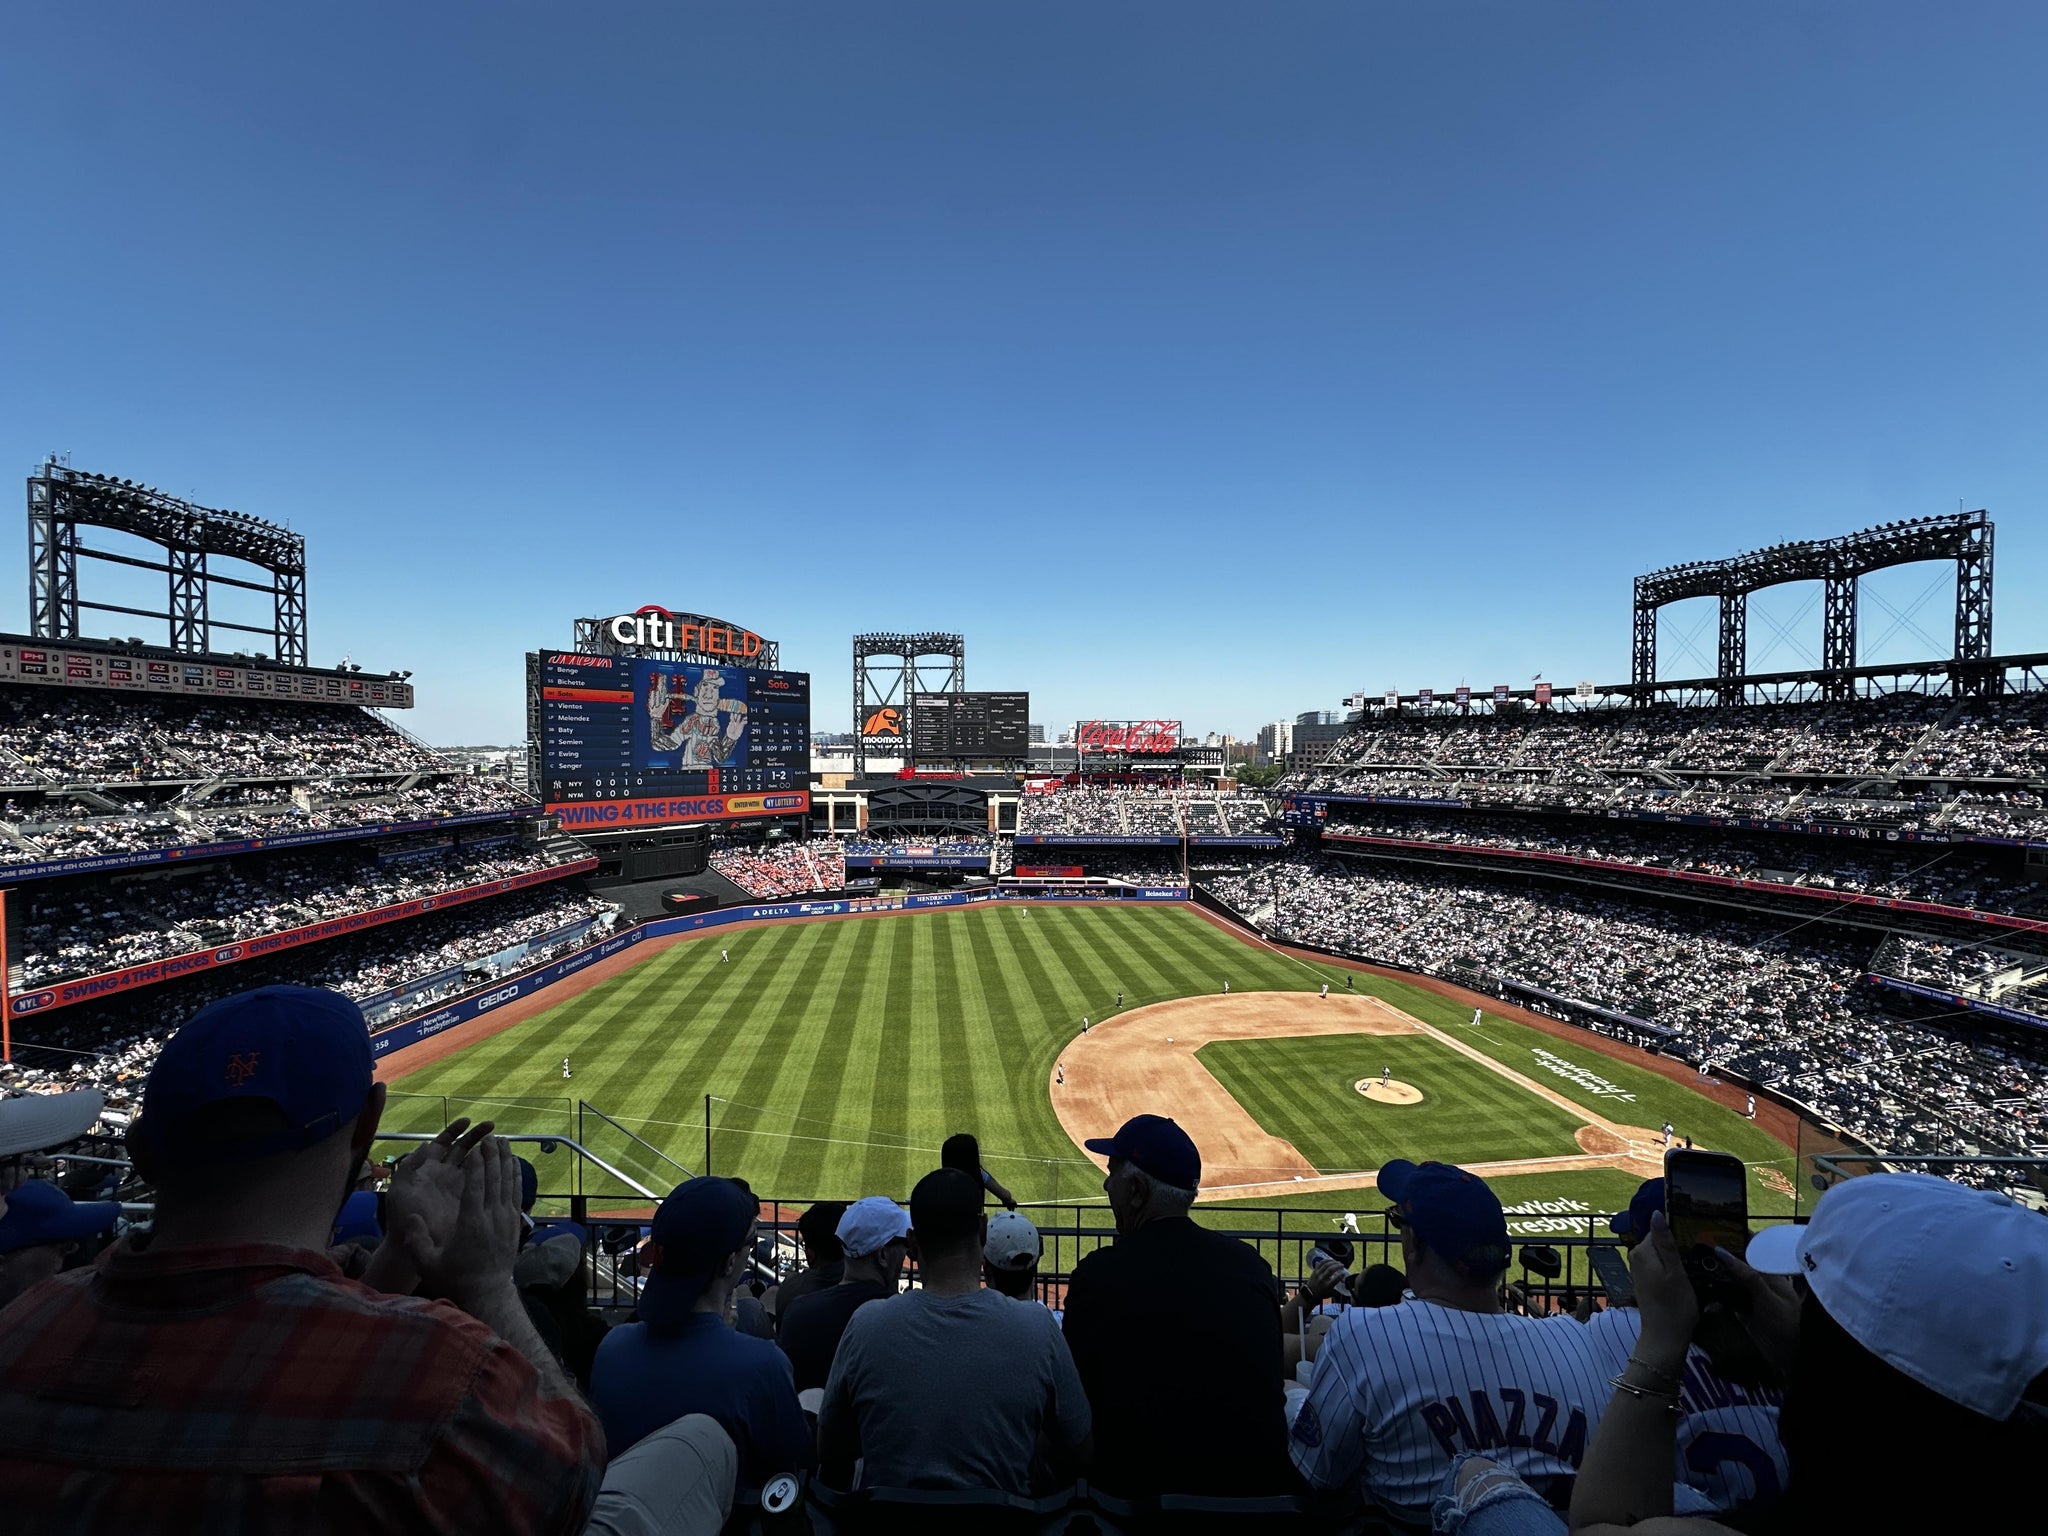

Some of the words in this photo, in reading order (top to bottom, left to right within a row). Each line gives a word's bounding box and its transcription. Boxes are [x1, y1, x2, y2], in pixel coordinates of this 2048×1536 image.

[611, 606, 674, 649] citi
[681, 623, 761, 657] FIELD
[24, 652, 45, 661] PHI
[52, 655, 60, 663] 0
[68, 656, 92, 665] BOS
[96, 658, 103, 667] 0
[6, 662, 11, 671] 1
[25, 665, 43, 674] PIT
[52, 666, 60, 675] 0
[113, 661, 128, 669] KC
[137, 662, 141, 670] 1
[557, 666, 579, 675] Benge
[70, 668, 91, 677] ATL
[96, 669, 104, 678] 5
[111, 672, 131, 680] STL
[136, 673, 143, 681] 0
[149, 675, 170, 683] COL
[173, 676, 179, 684] 0
[767, 679, 790, 690] Soto
[558, 727, 574, 735] Baty
[862, 736, 904, 744] moomoo
[1077, 720, 1181, 754] Coca-Cola
[558, 751, 579, 759] Ewing
[771, 770, 786, 781] 1-2
[595, 779, 602, 787] 0
[624, 778, 628, 786] 1
[595, 790, 602, 798] 0
[609, 789, 616, 797] 0
[623, 789, 630, 797] 0
[766, 799, 774, 807] NY
[1513, 804, 1542, 812] Rodriguez
[554, 805, 619, 825] SWING
[621, 803, 634, 820] 4
[634, 802, 666, 819] THE
[669, 799, 724, 817] FENCES
[1664, 814, 1682, 823] Soto
[1725, 819, 1740, 827] .291
[1818, 826, 1823, 834] 1
[1832, 827, 1839, 835] 2
[1850, 828, 1857, 836] 0
[1876, 830, 1881, 838] 1
[1920, 834, 1935, 842] Bot
[1935, 835, 1950, 843] 4th
[19, 867, 36, 876] RUN
[37, 866, 47, 874] IN
[49, 864, 62, 873] THE
[63, 862, 78, 871] 4TH
[79, 860, 104, 869] COULD
[104, 857, 119, 866] WIN
[119, 855, 136, 865] YOU
[137, 853, 161, 864] $15,000
[916, 894, 953, 902] HENDRICK'S
[762, 908, 790, 916] DELTA
[605, 937, 625, 952] Guardian
[631, 931, 642, 942] citi
[19, 998, 38, 1010] NYL
[62, 976, 119, 1001] SWING
[119, 974, 131, 986] 4
[131, 967, 159, 984] THE
[160, 954, 210, 978] FENCES
[218, 950, 233, 962] NYL
[249, 937, 282, 954] ENTER
[283, 932, 301, 945] ON
[302, 927, 320, 940] THE
[321, 922, 343, 936] NEW
[344, 916, 368, 931] YORK
[369, 908, 402, 924] LOTTERY
[402, 903, 417, 916] APP
[565, 958, 583, 972] Invesco
[534, 976, 544, 986] 370
[478, 984, 519, 1011] GEICO
[423, 1011, 453, 1028] NewYork-
[423, 1016, 460, 1036] Presbyterian
[374, 1039, 389, 1052] 358
[1502, 1196, 1590, 1214] ewYork-
[1420, 1387, 1587, 1470] PIAZZA
